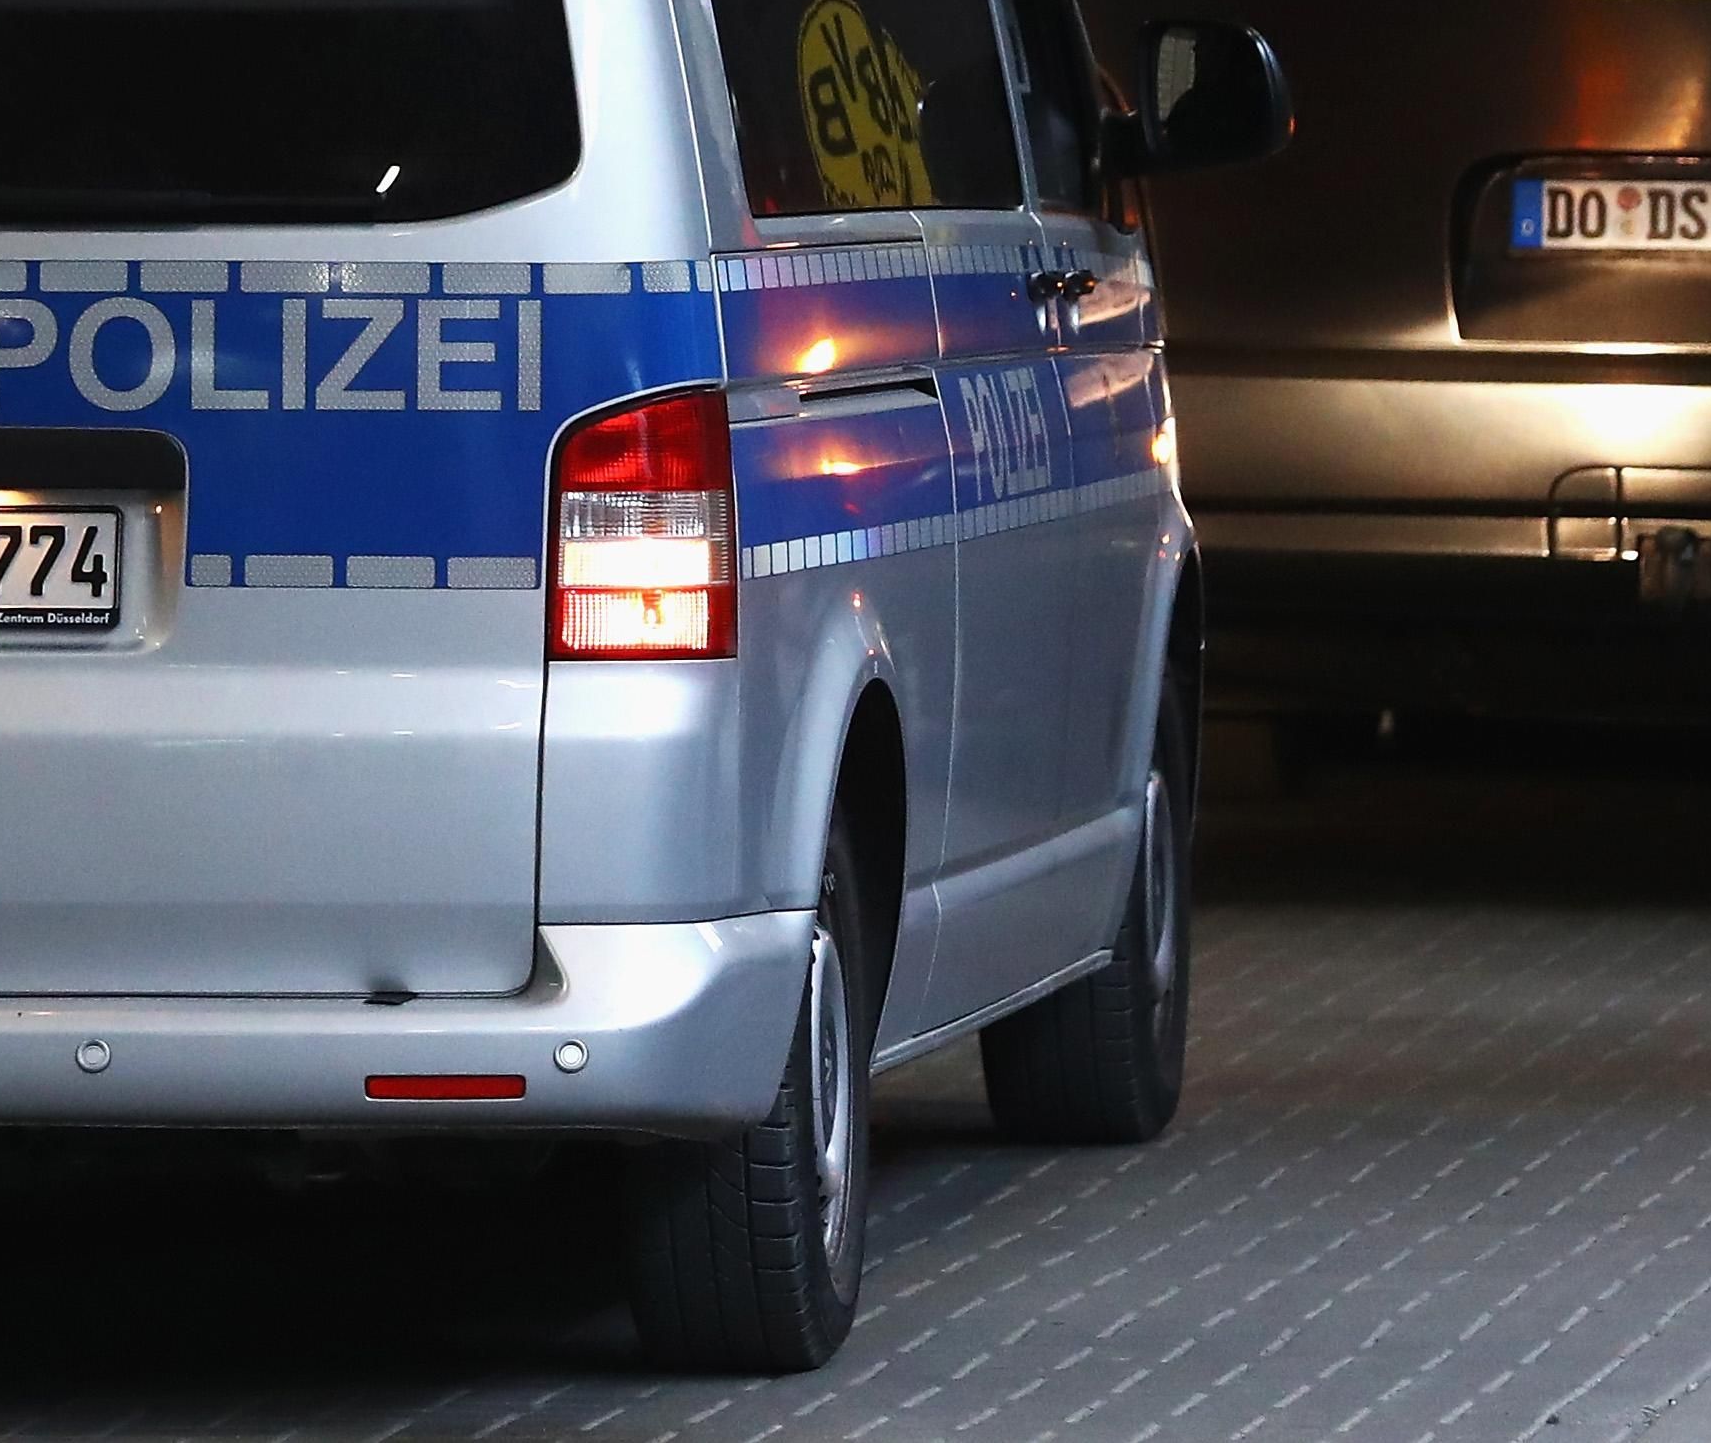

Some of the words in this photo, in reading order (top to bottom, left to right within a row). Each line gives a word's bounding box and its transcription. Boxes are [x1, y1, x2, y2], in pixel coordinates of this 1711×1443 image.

[1546, 186, 1607, 239] DO
[1646, 189, 1708, 241] DS
[958, 365, 1052, 501] POLIZEI
[46, 612, 111, 624] Düsseldorf
